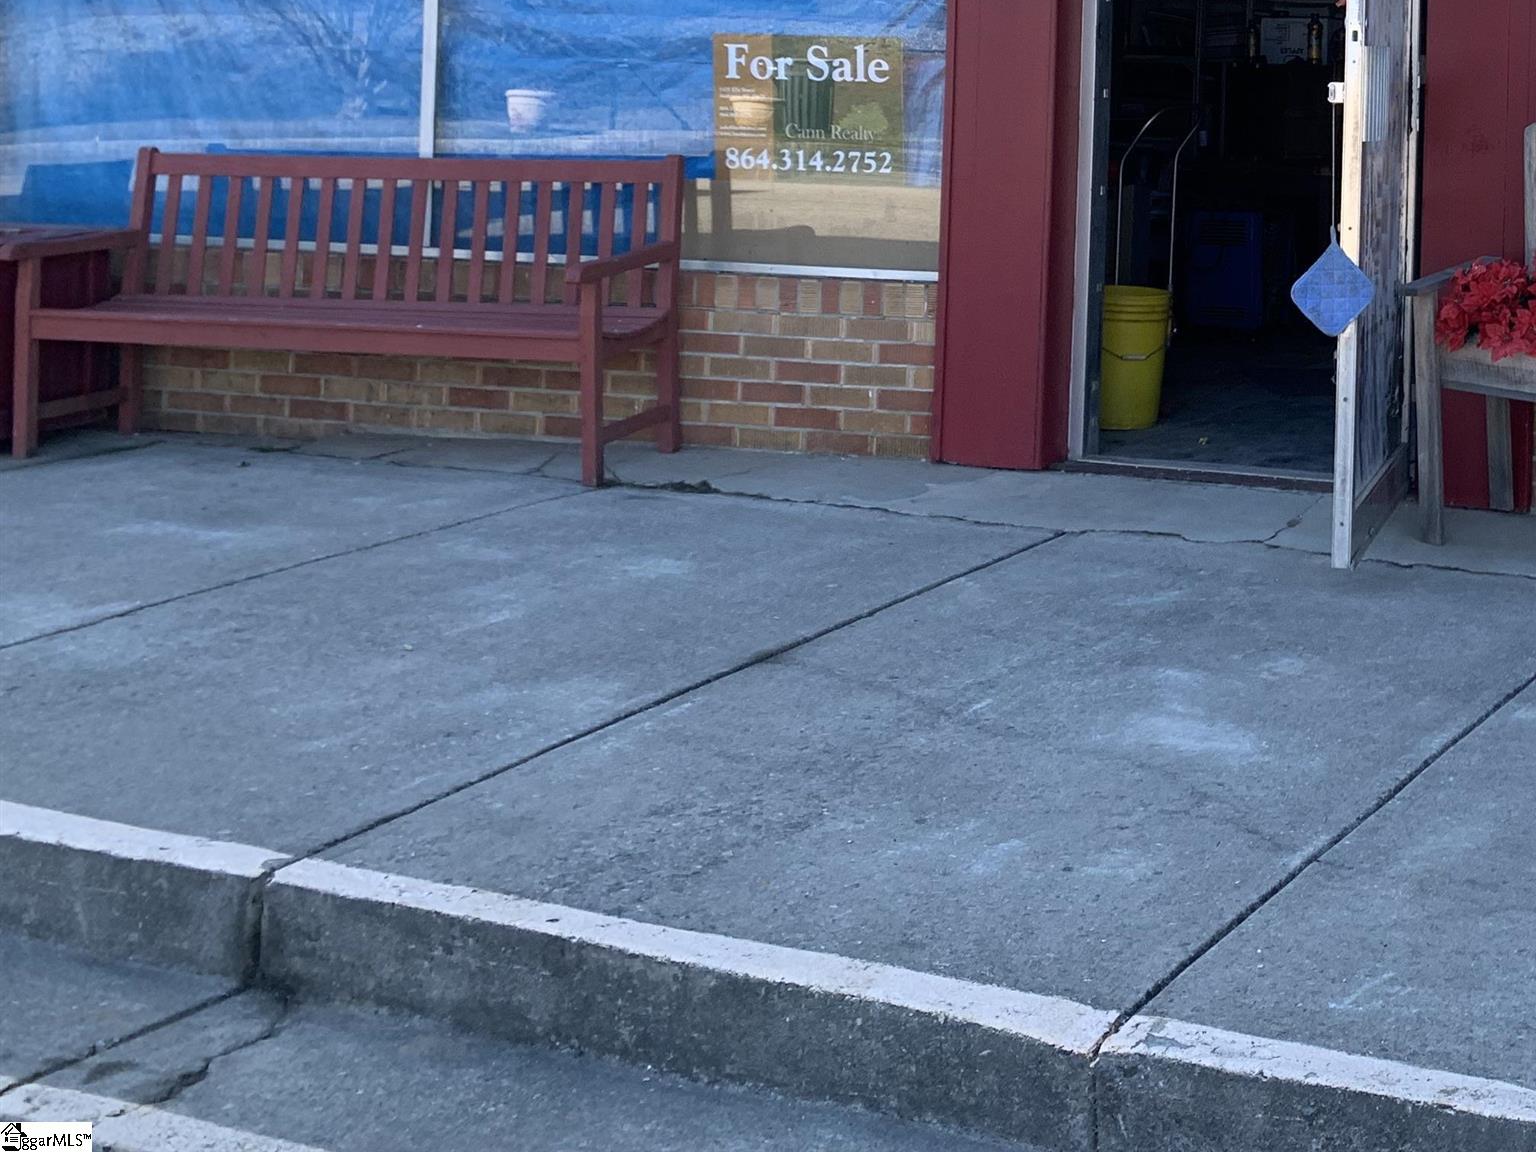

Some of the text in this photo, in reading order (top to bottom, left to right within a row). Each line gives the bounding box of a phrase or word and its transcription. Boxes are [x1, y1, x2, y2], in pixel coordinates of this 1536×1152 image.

[724, 43, 891, 84] For Sale
[785, 123, 826, 140] Cann
[831, 124, 874, 144] Realty
[725, 147, 893, 174] 864.314.2752
